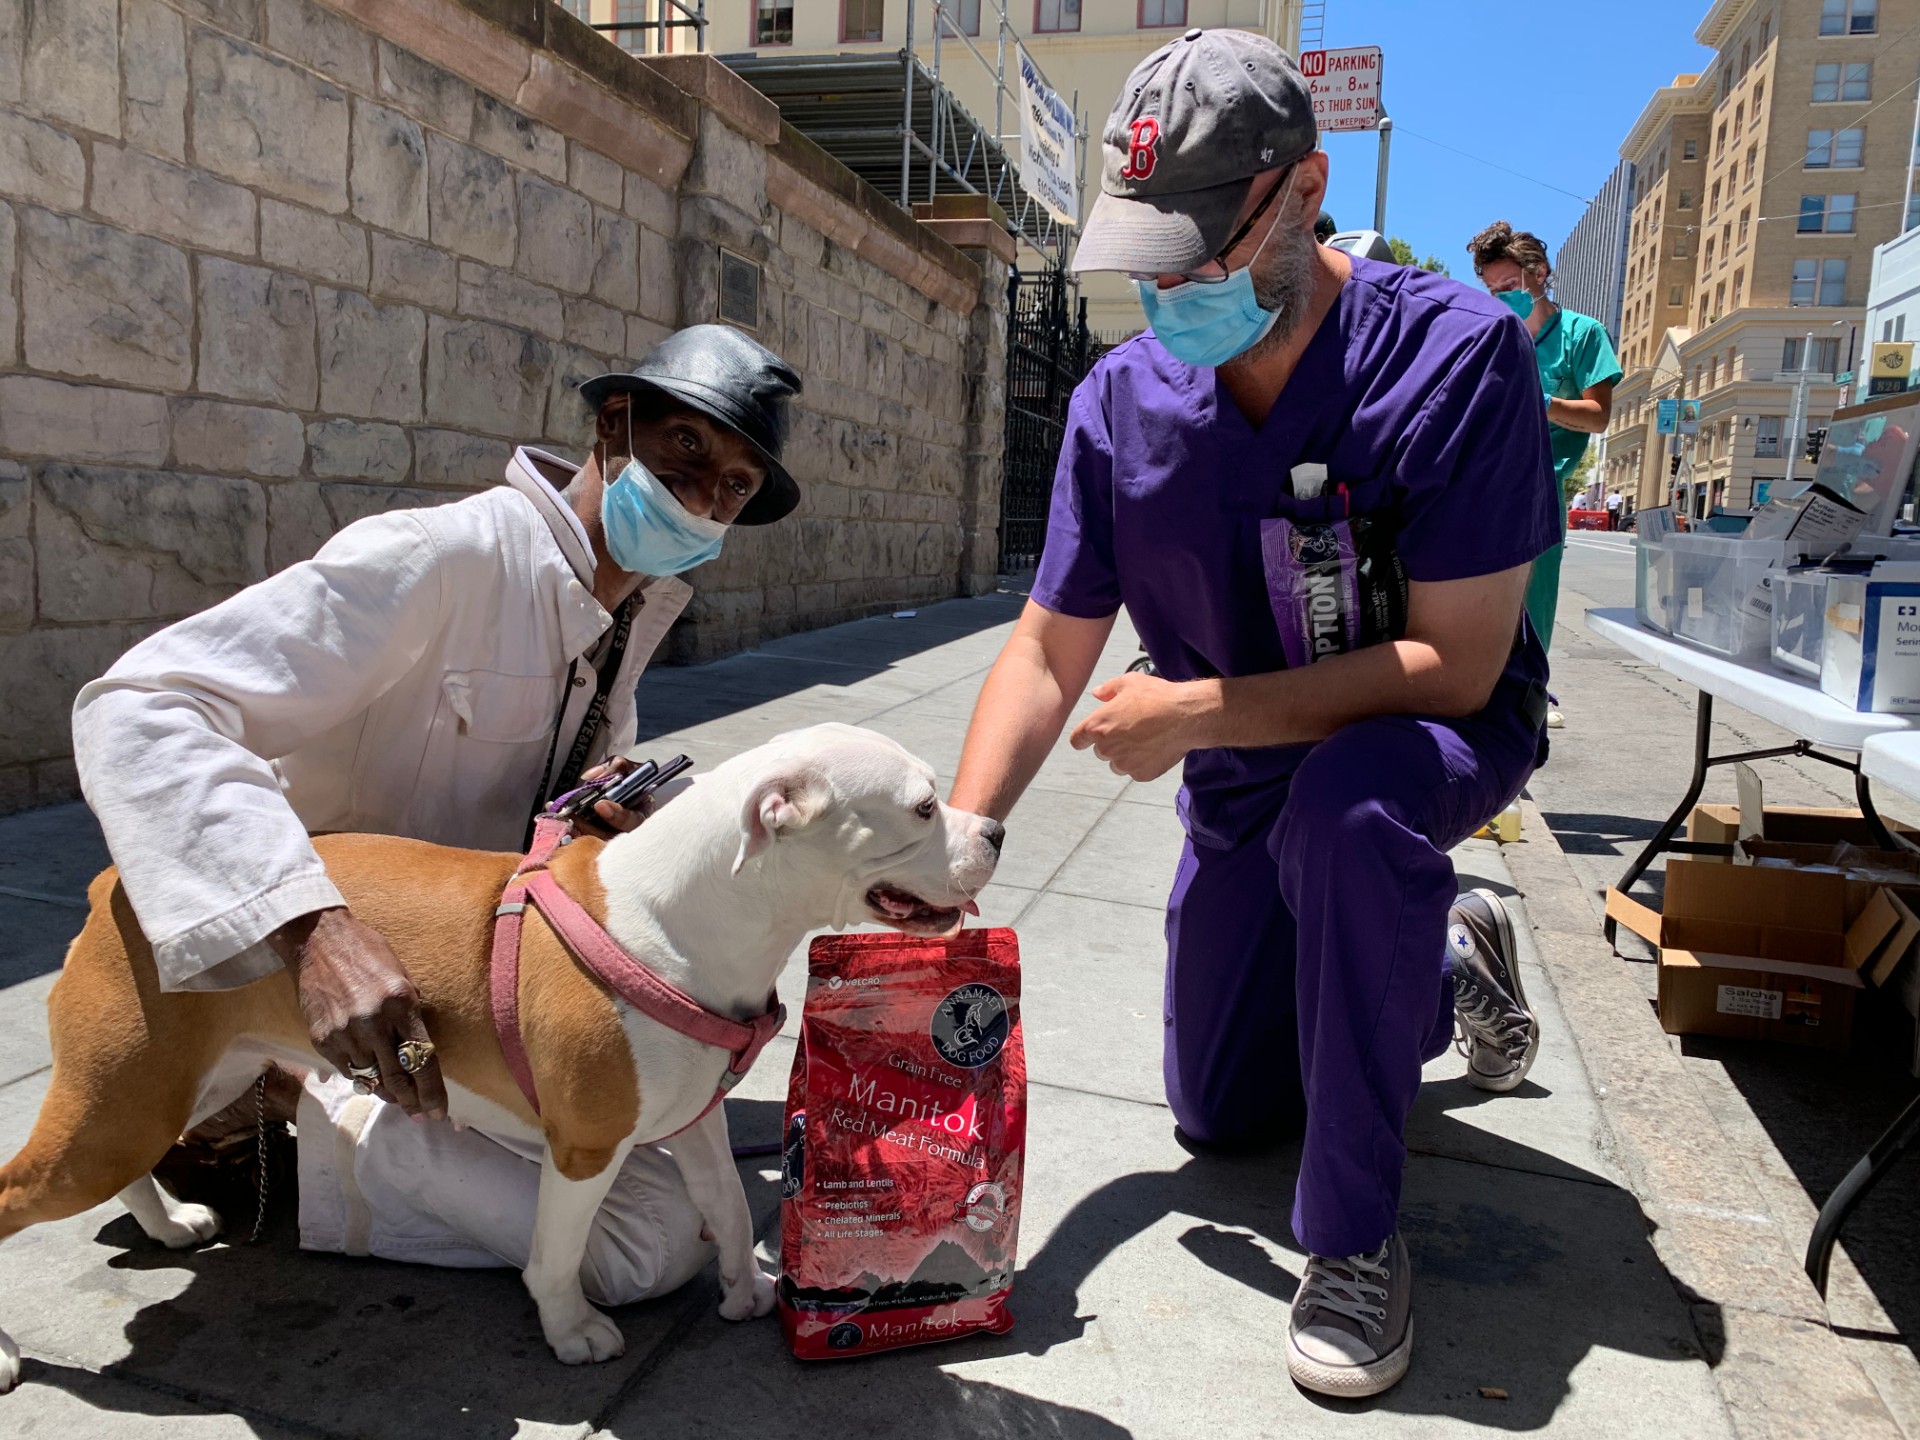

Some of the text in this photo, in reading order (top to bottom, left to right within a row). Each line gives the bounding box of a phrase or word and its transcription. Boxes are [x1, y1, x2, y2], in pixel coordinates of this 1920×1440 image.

[1303, 53, 1376, 75] NO PARKING
[1313, 97, 1375, 113] ES THUR SUN
[1335, 116, 1370, 127] SWEEPING
[1122, 116, 1162, 181] B
[1877, 381, 1901, 393] 826
[1392, 555, 1404, 579] OMEGA
[1379, 590, 1388, 606] RICE
[1311, 575, 1339, 660] PTION
[1897, 621, 1920, 632] Mo
[1725, 987, 1777, 1001] Salcha
[941, 988, 1001, 1018] ANNAMAET
[941, 1036, 999, 1062] DOG FOOD
[888, 1053, 962, 1088] Grain Free
[848, 1072, 985, 1140] Manitok
[831, 1107, 867, 1133] Red
[868, 1121, 916, 1148] Meat
[919, 1135, 985, 1169] Formula
[783, 1177, 799, 1194] OOD
[823, 1178, 894, 1189] Lamb and Lentils
[825, 1200, 868, 1210] Prebiotics
[825, 1212, 901, 1225] Chelated Minerals
[838, 1230, 852, 1238] Life
[855, 1228, 884, 1238] Stages
[868, 1308, 962, 1339] Manitok
